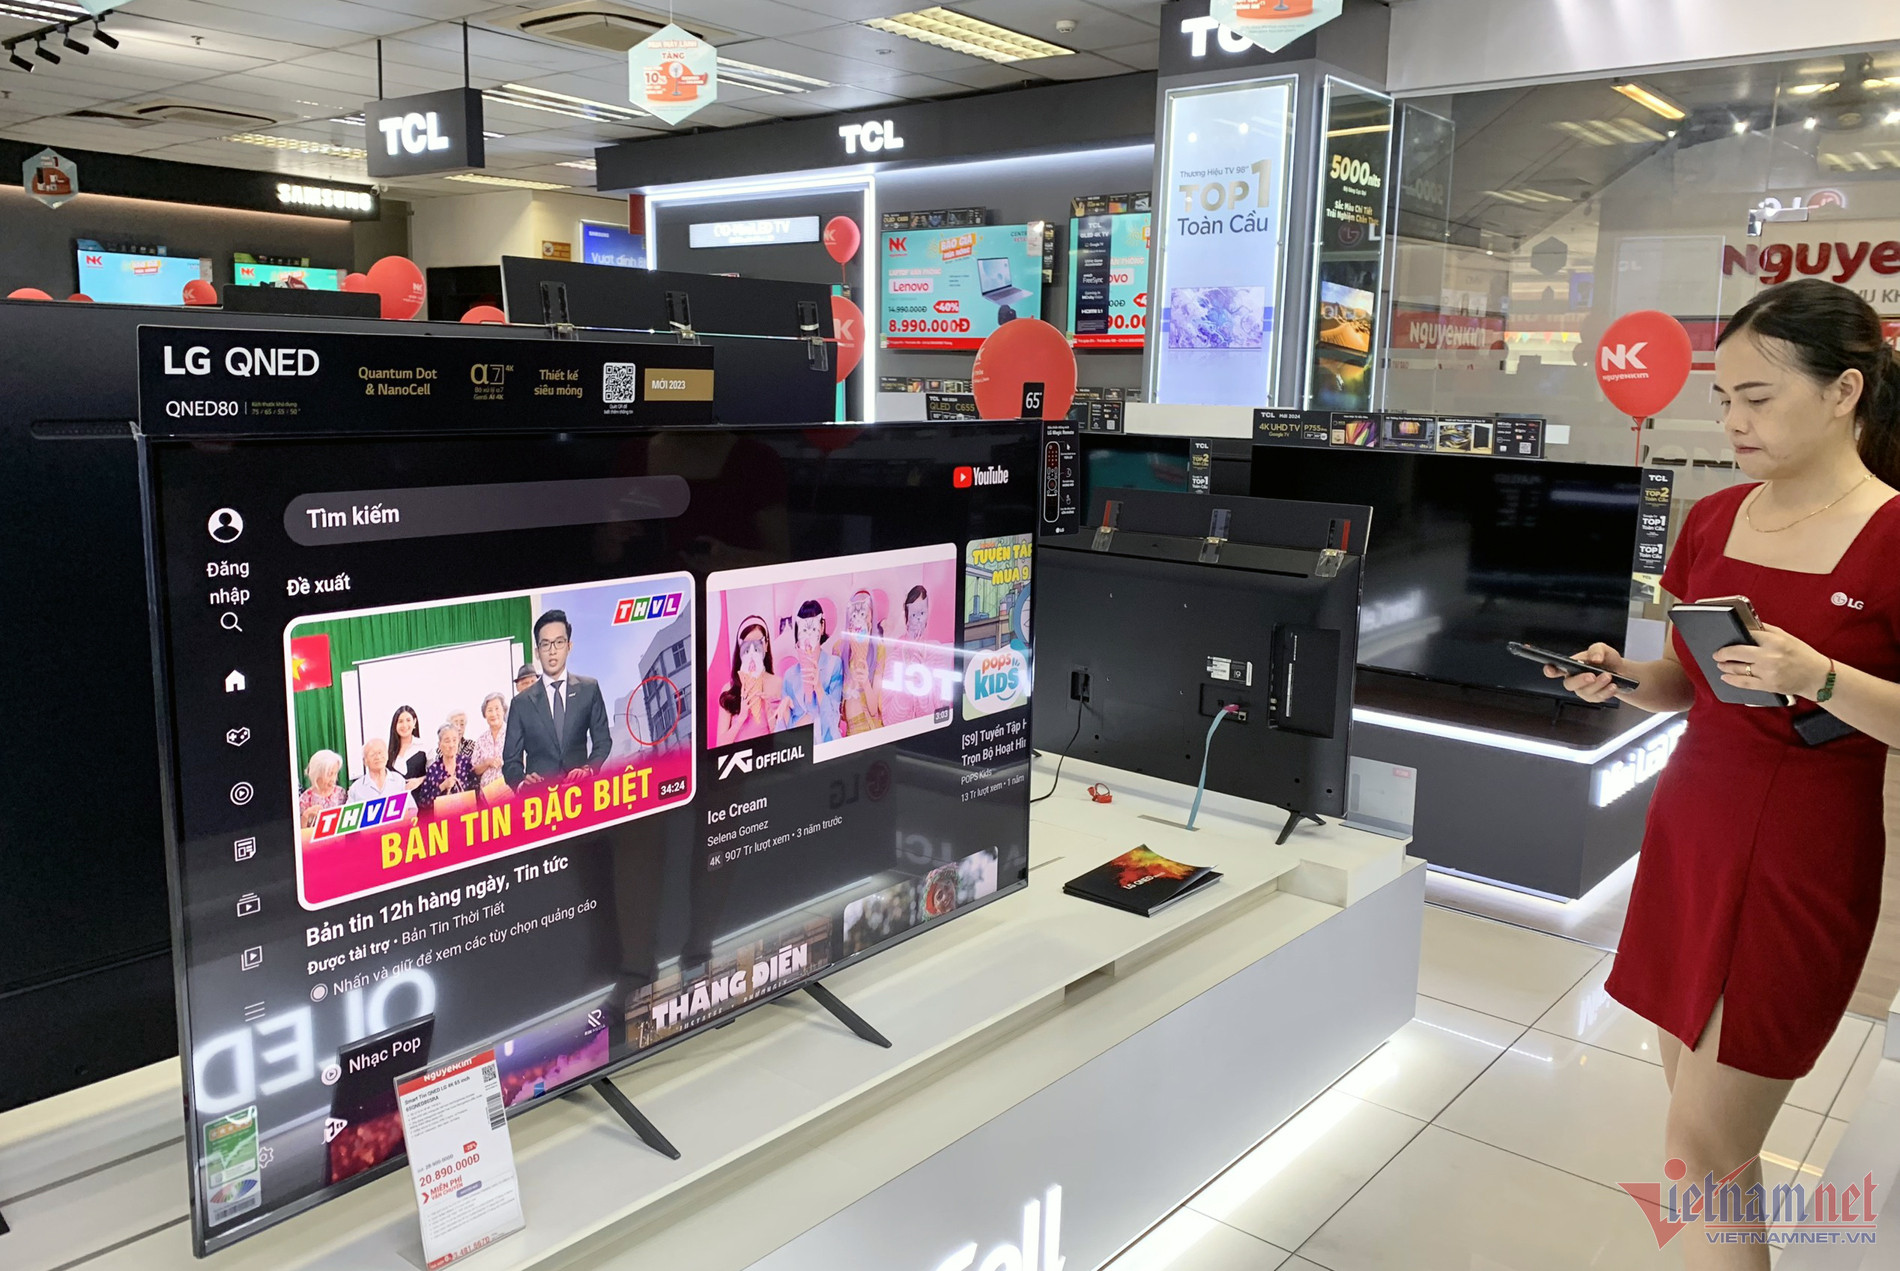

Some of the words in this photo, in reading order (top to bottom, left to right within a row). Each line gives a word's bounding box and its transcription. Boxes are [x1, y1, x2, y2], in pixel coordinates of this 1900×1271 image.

[379, 111, 449, 156] TCL
[839, 120, 904, 154] TCL
[277, 183, 372, 211] SAMSUNG
[1178, 217, 1223, 235] Toàn
[1230, 210, 1268, 233] Cầu
[889, 237, 908, 252] NK
[893, 281, 929, 292] Lenovo
[163, 346, 211, 375] LG
[225, 346, 320, 377] QNED
[1601, 342, 1648, 371] NK
[358, 367, 412, 380] Quantum
[414, 367, 437, 380] Dot
[539, 369, 564, 381] Thiết
[566, 369, 579, 381] kế
[652, 378, 668, 390] MỚI
[669, 380, 686, 389] 2023
[365, 384, 375, 395] &
[378, 383, 430, 396] NanoCell
[534, 384, 554, 396] siêu
[556, 384, 583, 398] mỏng
[165, 401, 239, 418] QNED80
[930, 403, 950, 411] QLED
[955, 403, 975, 412] C655
[1259, 423, 1270, 431] 4K
[1271, 423, 1288, 431] UHD
[1289, 424, 1300, 432] TV
[973, 465, 1008, 486] YouTube
[306, 507, 347, 529] Tìm
[352, 503, 400, 527] kiếm
[206, 561, 250, 581] Đăng
[992, 567, 1020, 586] MÙA
[1022, 566, 1029, 580] 9
[209, 586, 250, 607] nhập
[287, 577, 310, 598] Đề
[315, 574, 351, 594] xuất
[615, 593, 681, 624] THVL
[1847, 598, 1864, 610] LG
[982, 654, 1011, 673] pops
[975, 667, 1019, 701] KIDS
[935, 710, 948, 720] 3:03
[962, 731, 978, 750] [S9]
[980, 724, 1004, 741] Tuyển
[1006, 720, 1021, 735] Tập
[756, 745, 804, 770] OFFICIAL
[962, 753, 980, 766] Trọn
[983, 747, 993, 760] Bộ
[995, 740, 1014, 756] Hoạt
[660, 780, 685, 796] 34:24
[961, 772, 978, 785] POPS
[980, 768, 992, 779] Kids
[961, 793, 968, 802] 13
[970, 790, 976, 799] Tr
[977, 786, 989, 797] lượt
[990, 782, 1002, 792] xem
[1012, 774, 1024, 785] năm
[318, 796, 406, 834] THVL
[381, 816, 450, 869] BẢN
[461, 803, 512, 848] TIN
[523, 786, 583, 832] ĐẶC
[594, 765, 653, 811] BIỆT
[707, 809, 725, 824] Ice
[729, 797, 768, 817] Cream
[707, 831, 736, 847] Selena
[739, 820, 769, 837] Gomez
[710, 854, 721, 866] 4K
[725, 848, 741, 862] 907
[744, 845, 752, 856] Tr
[754, 837, 771, 851] lượt
[772, 833, 790, 846] xem
[796, 828, 802, 838] 3
[803, 823, 821, 836] năm
[822, 815, 843, 829] trước
[306, 921, 344, 947] Bản
[349, 913, 373, 933] tin
[380, 900, 413, 924] 12h
[418, 888, 460, 912] hàng
[465, 875, 510, 899] ngày,
[514, 864, 539, 883] Tin
[543, 855, 568, 875] tức
[307, 954, 345, 975] Được
[349, 944, 367, 962] tài
[370, 939, 390, 956] trợ
[402, 927, 427, 945] Bản
[430, 921, 449, 936] Tin
[453, 910, 479, 928] Thời
[482, 900, 505, 919] Tiết
[333, 974, 370, 995] Nhấn
[373, 966, 388, 981] và
[392, 959, 413, 977] giữ
[416, 950, 433, 967] để
[435, 946, 462, 962] xem
[465, 935, 486, 951] các
[489, 929, 508, 943] tùy
[510, 919, 538, 937] chọn
[541, 908, 575, 928] quảng
[577, 899, 597, 914] cáo
[349, 1046, 388, 1073] Nhạc
[392, 1036, 421, 1057] Pop
[419, 1153, 480, 1187] 20.890.000Đ
